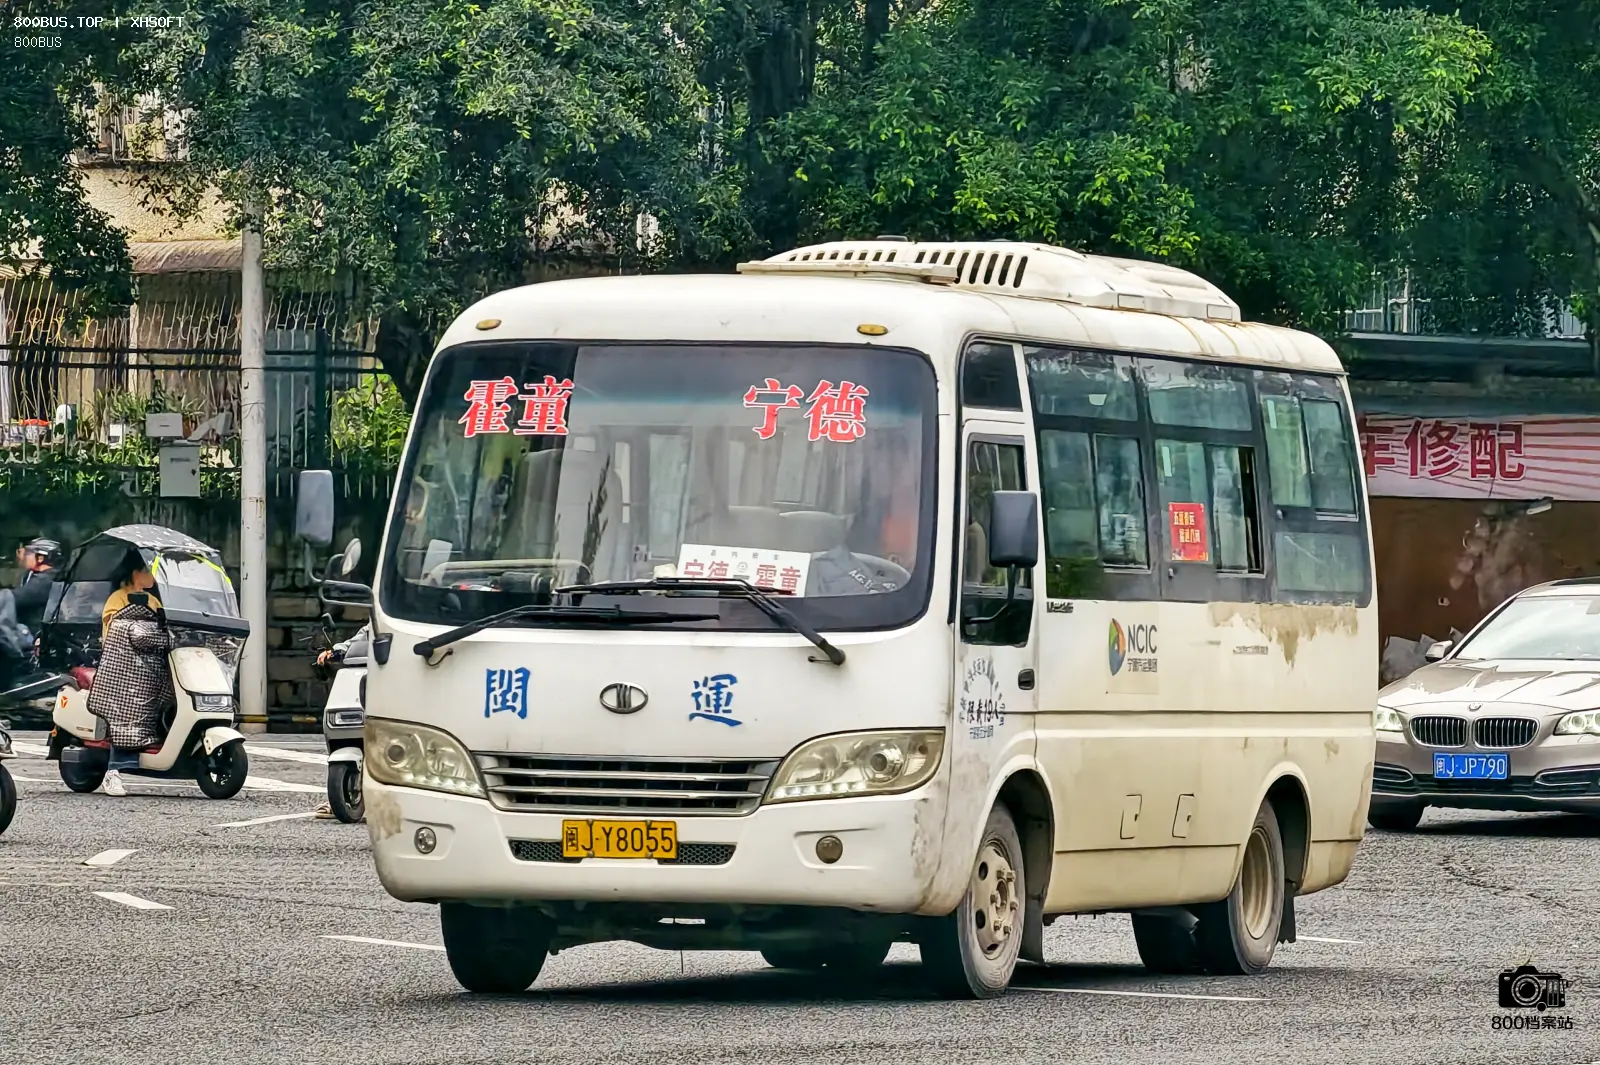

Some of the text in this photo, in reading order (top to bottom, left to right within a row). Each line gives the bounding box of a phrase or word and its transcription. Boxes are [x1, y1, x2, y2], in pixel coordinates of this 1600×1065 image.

[457, 376, 870, 443] 霍童 宁德
[1127, 624, 1158, 654] NCIC
